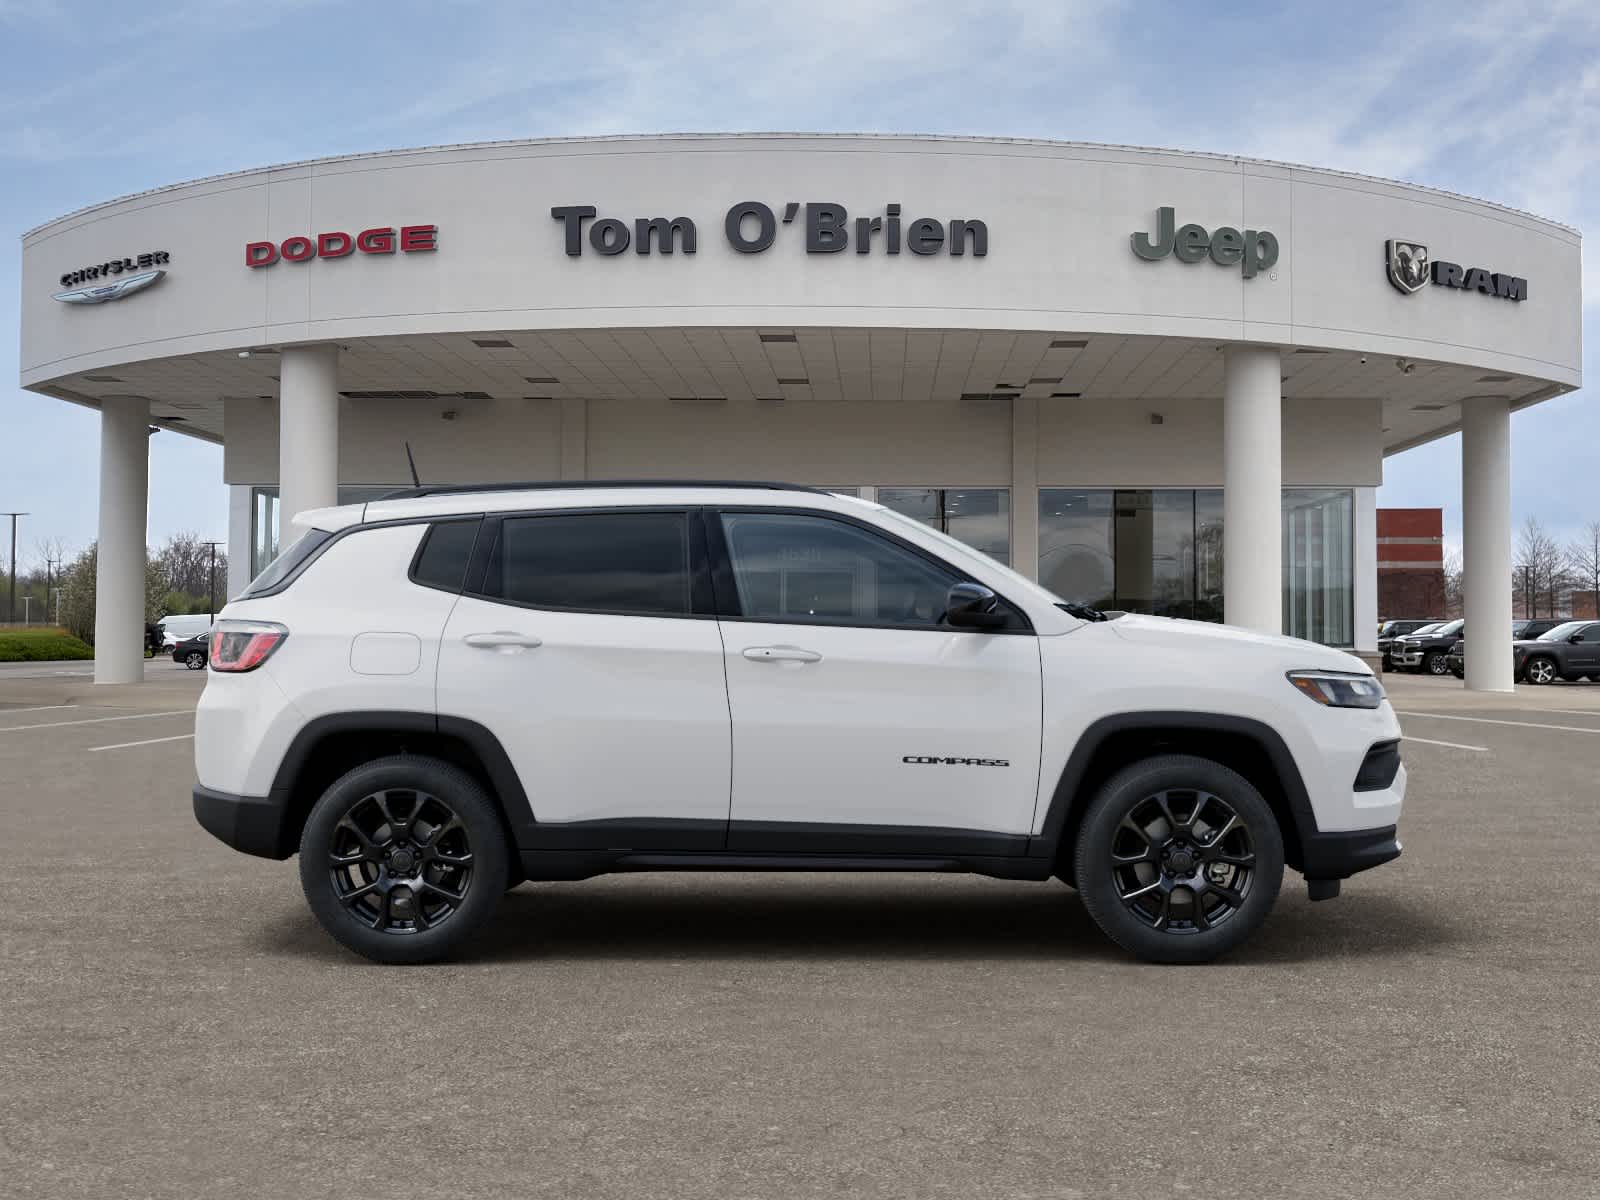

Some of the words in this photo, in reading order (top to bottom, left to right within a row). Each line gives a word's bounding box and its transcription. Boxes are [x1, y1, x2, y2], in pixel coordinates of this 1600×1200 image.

[245, 224, 438, 269] DODGE
[551, 205, 697, 256] Tom
[725, 201, 988, 257] O'Brien
[1130, 206, 1279, 279] Jeep
[60, 250, 170, 287] CHRYSLER
[1431, 261, 1527, 302] RAM
[902, 756, 1010, 767] COMPASS
